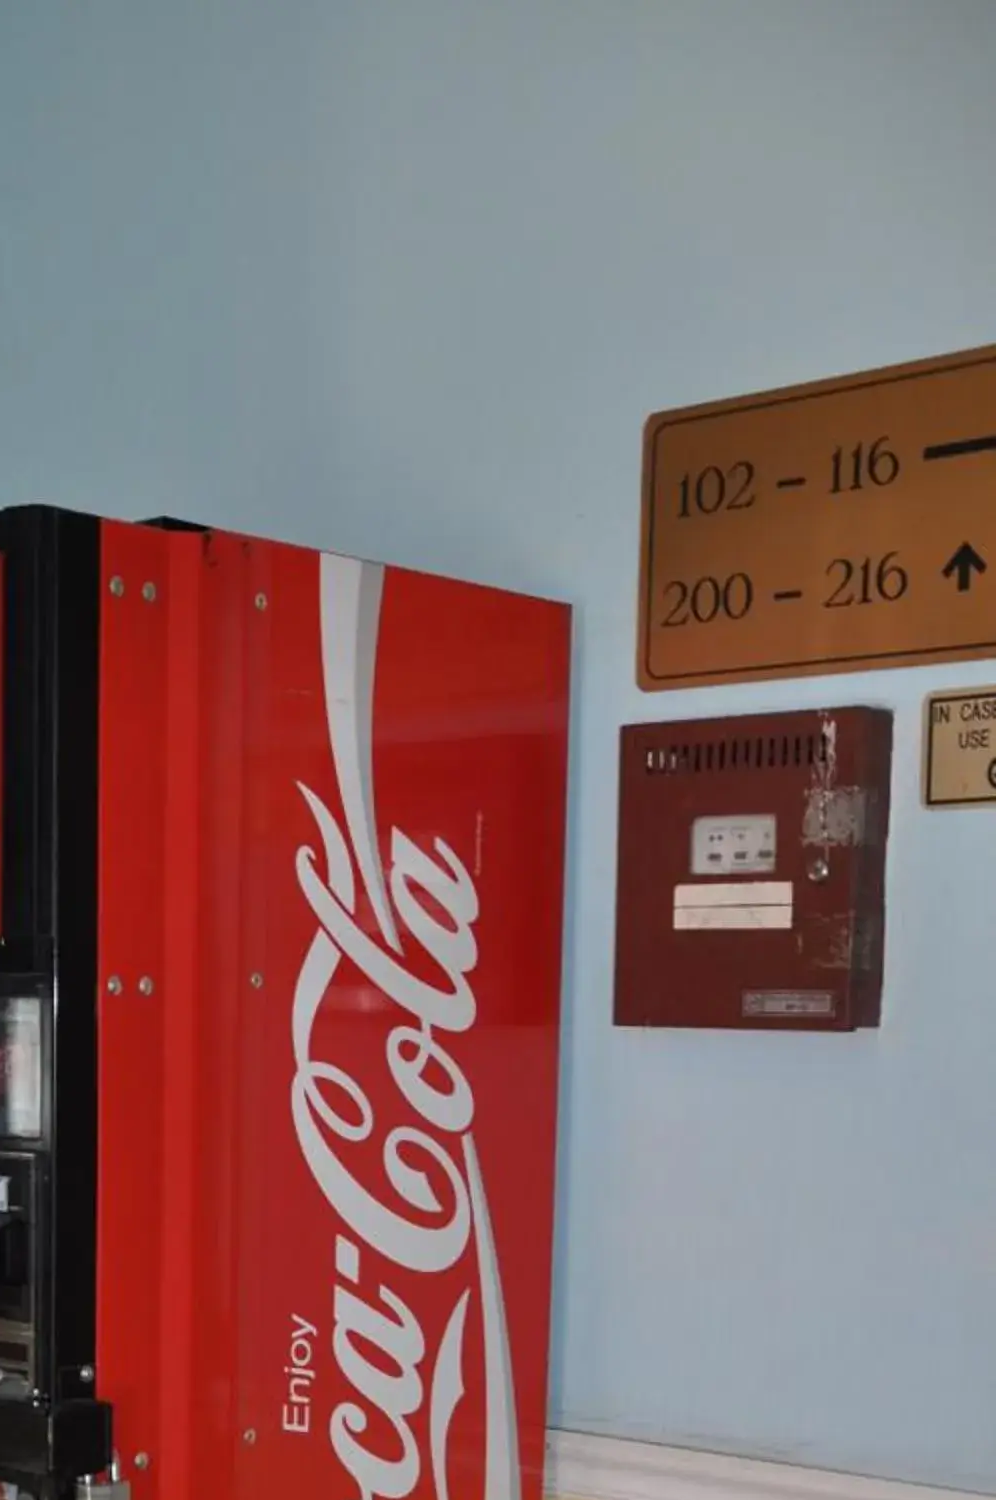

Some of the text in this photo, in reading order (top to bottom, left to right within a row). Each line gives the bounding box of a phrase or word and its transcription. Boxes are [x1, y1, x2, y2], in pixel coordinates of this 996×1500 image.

[677, 460, 756, 518] 102
[829, 435, 900, 494] 116
[661, 572, 753, 627] 200
[822, 551, 908, 608] 216
[958, 728, 989, 749] USE
[282, 1312, 318, 1433] Enjoy
